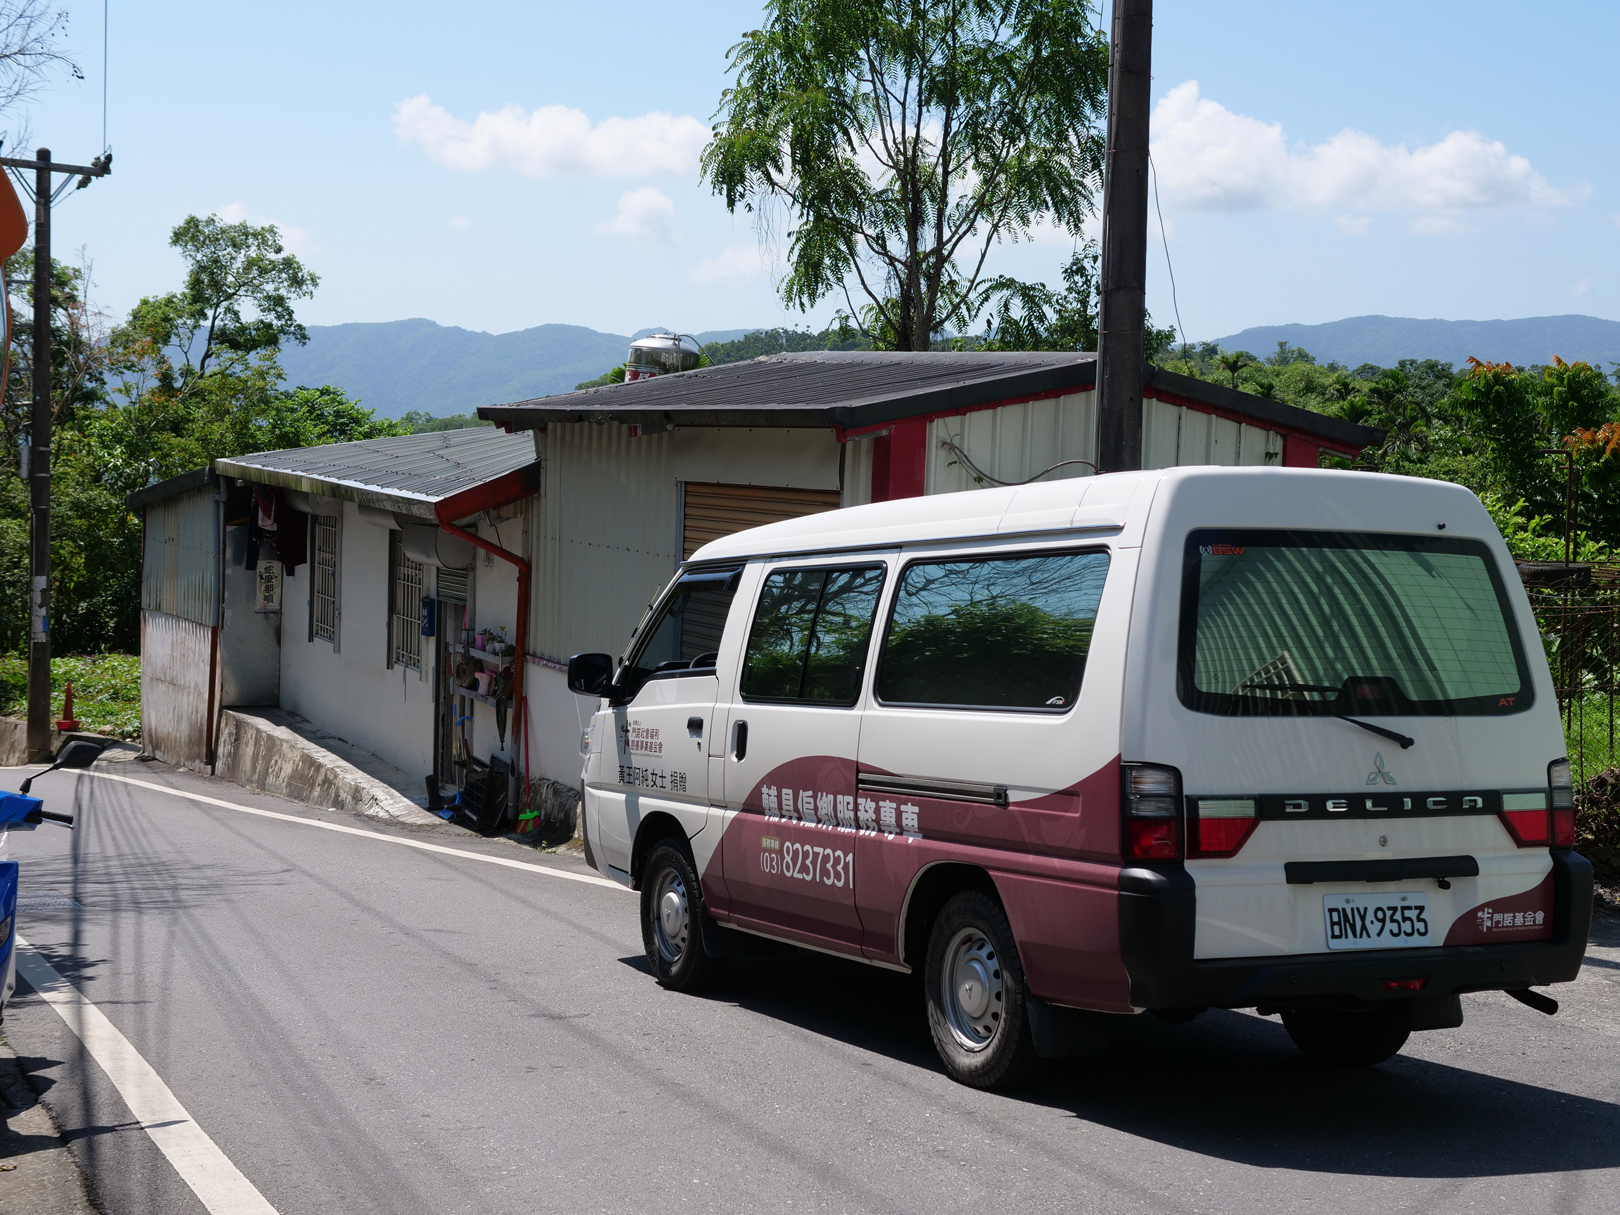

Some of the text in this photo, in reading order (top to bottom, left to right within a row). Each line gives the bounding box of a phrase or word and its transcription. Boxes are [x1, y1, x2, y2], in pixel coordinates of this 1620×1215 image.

[1212, 547, 1244, 555] BSW
[1498, 697, 1515, 707] AT
[1284, 796, 1484, 813] DELICA
[761, 784, 923, 843] 輔具偏鄉服務專車
[783, 841, 853, 889] 8237331
[1492, 910, 1545, 927] 門諾基金會
